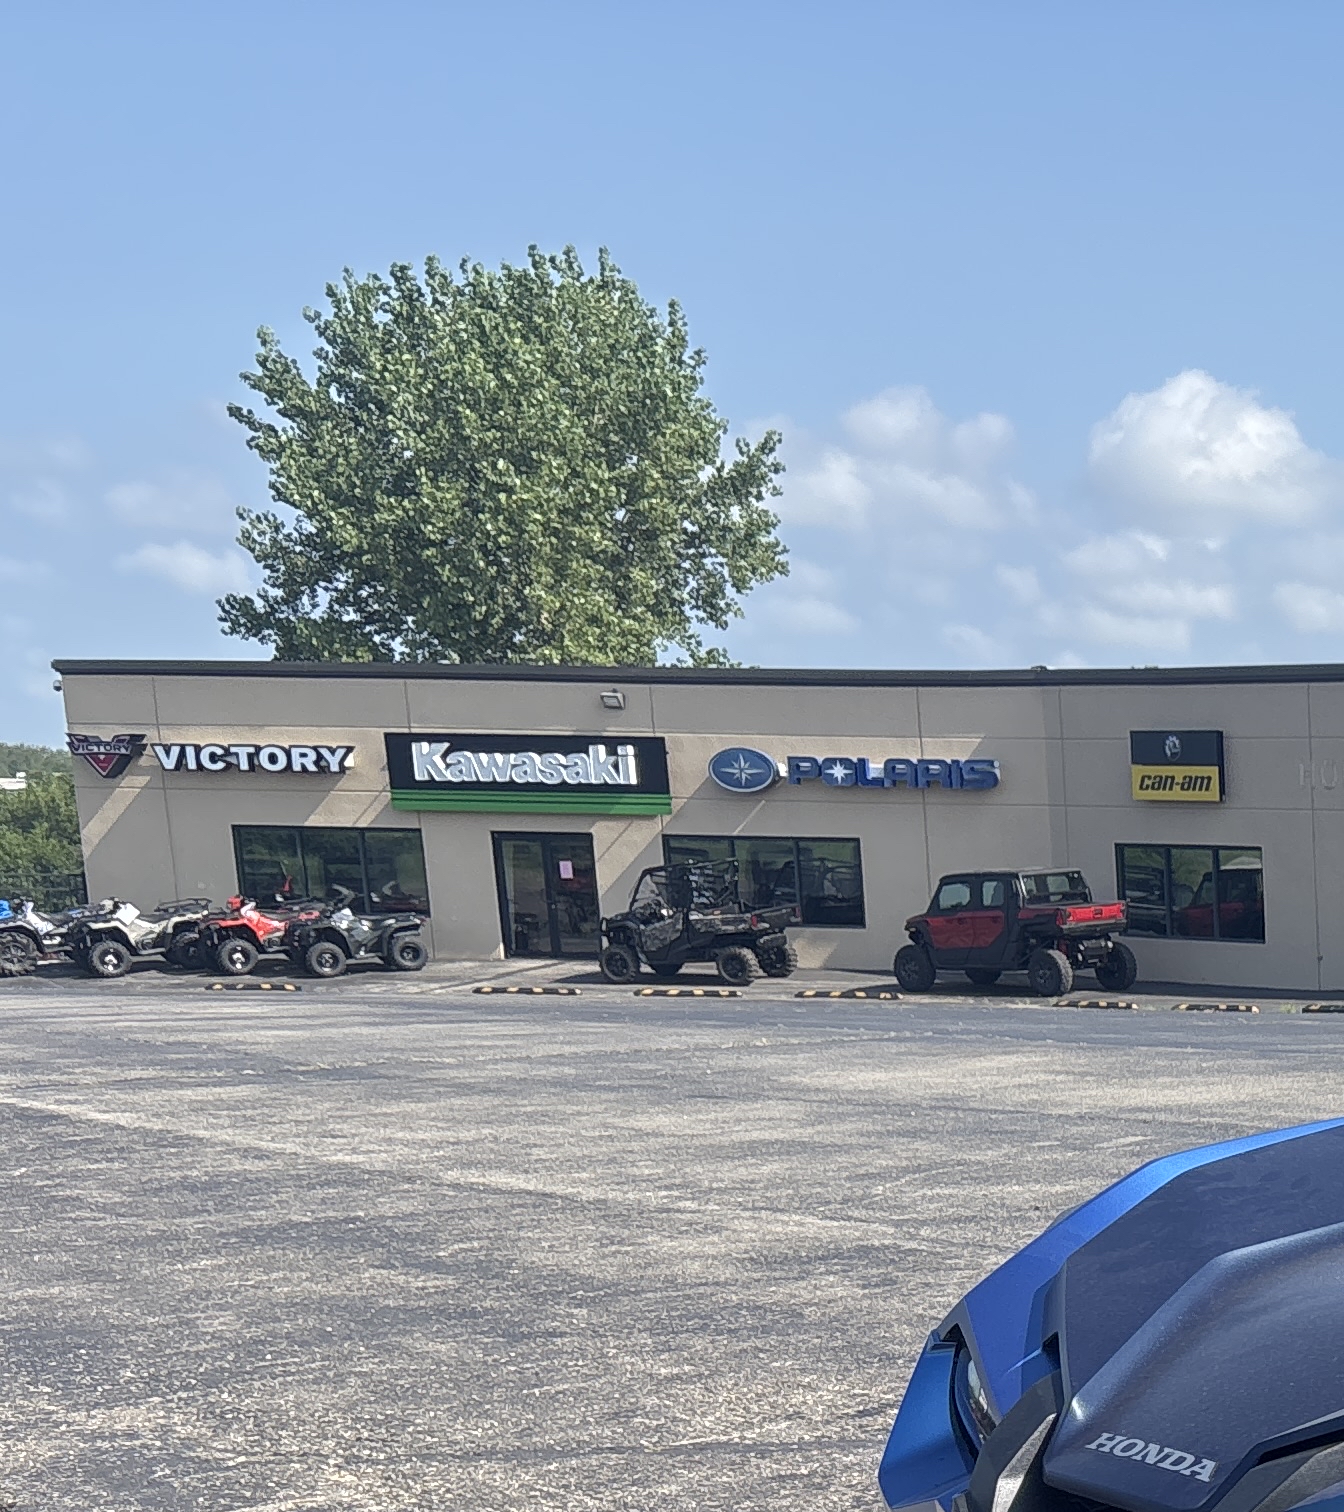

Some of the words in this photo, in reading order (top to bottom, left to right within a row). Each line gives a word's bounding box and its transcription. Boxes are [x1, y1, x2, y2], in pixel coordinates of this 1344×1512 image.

[71, 742, 132, 753] VICTORY
[152, 743, 352, 772] VICTORY
[411, 741, 638, 785] Kawasaki
[787, 756, 1000, 790] POLARIS
[1139, 774, 1213, 792] can-am
[1084, 1432, 1219, 1483] HONDA
